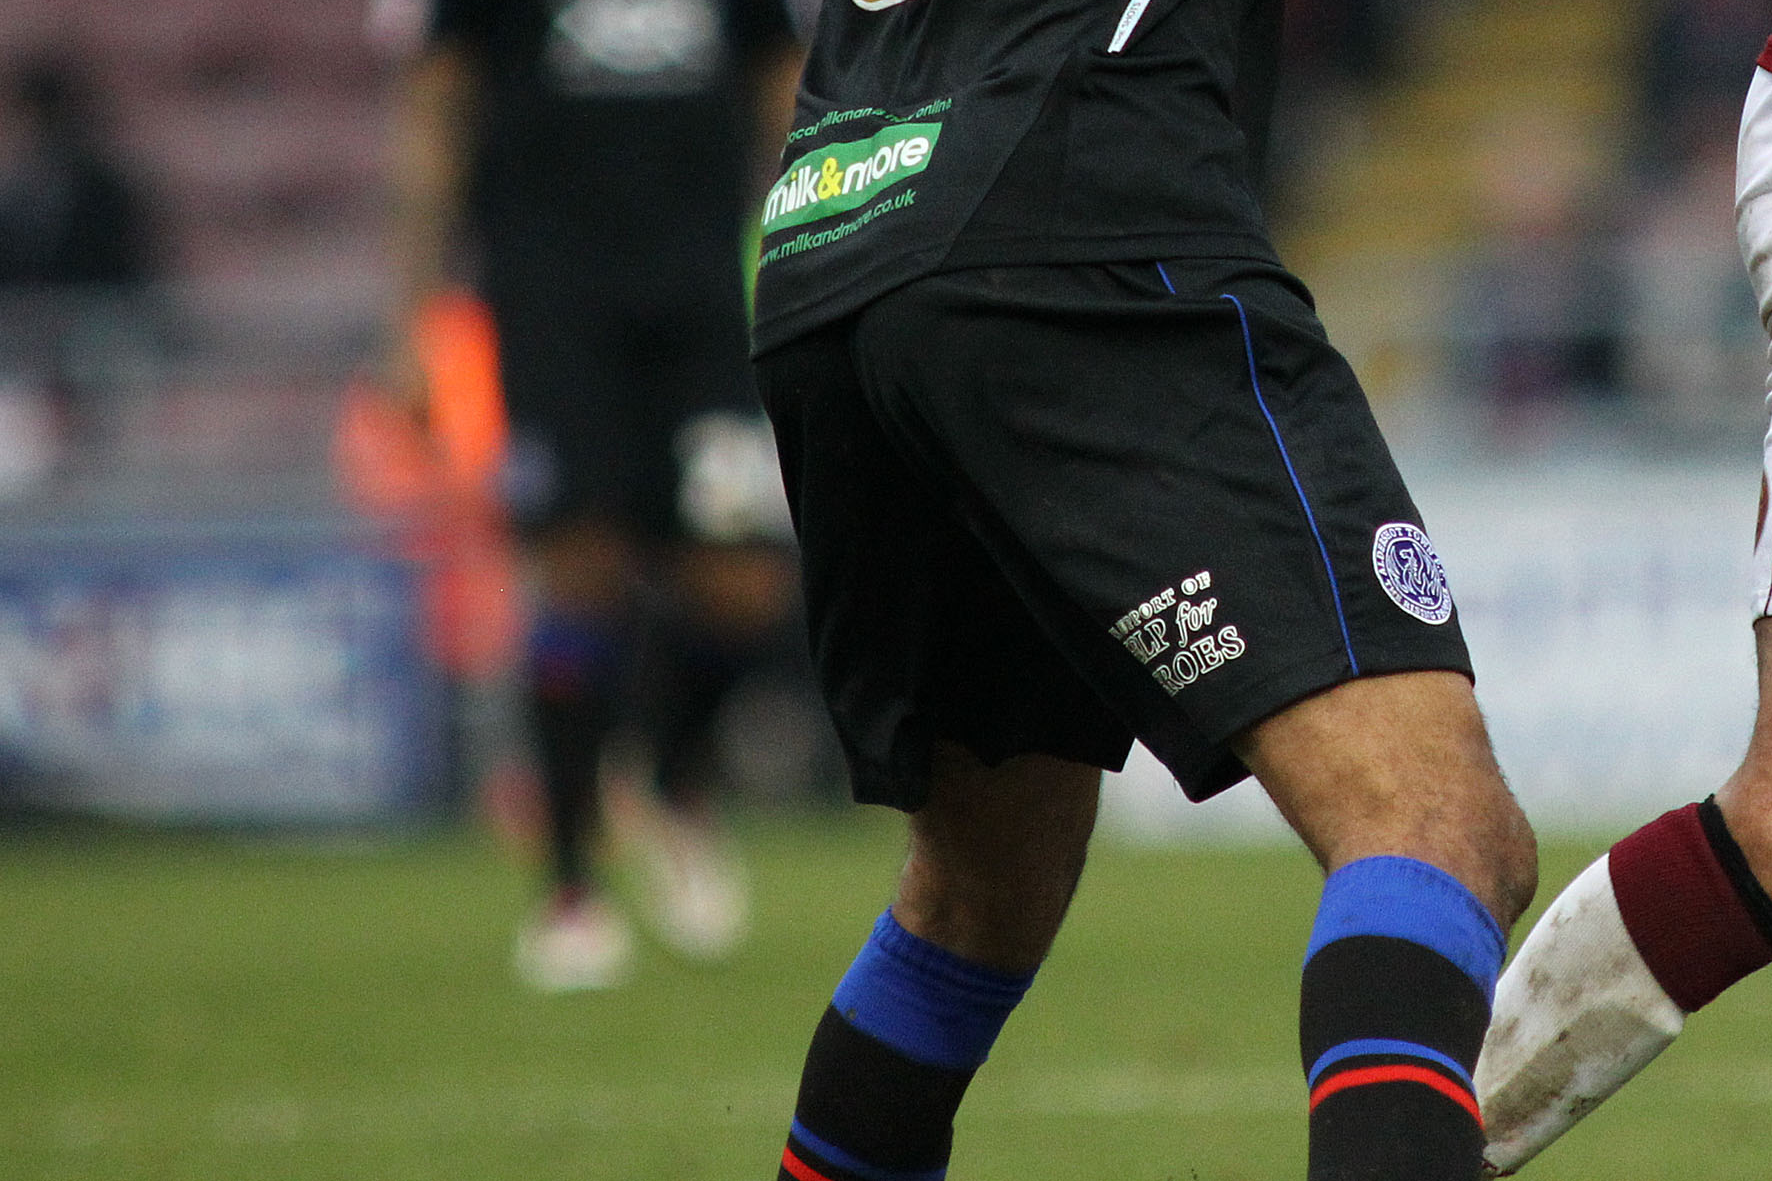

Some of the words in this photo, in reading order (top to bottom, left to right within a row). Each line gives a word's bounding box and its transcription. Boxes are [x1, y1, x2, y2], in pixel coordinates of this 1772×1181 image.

[762, 136, 930, 225] milk&more
[1180, 571, 1211, 596] OF
[1175, 598, 1218, 648] for
